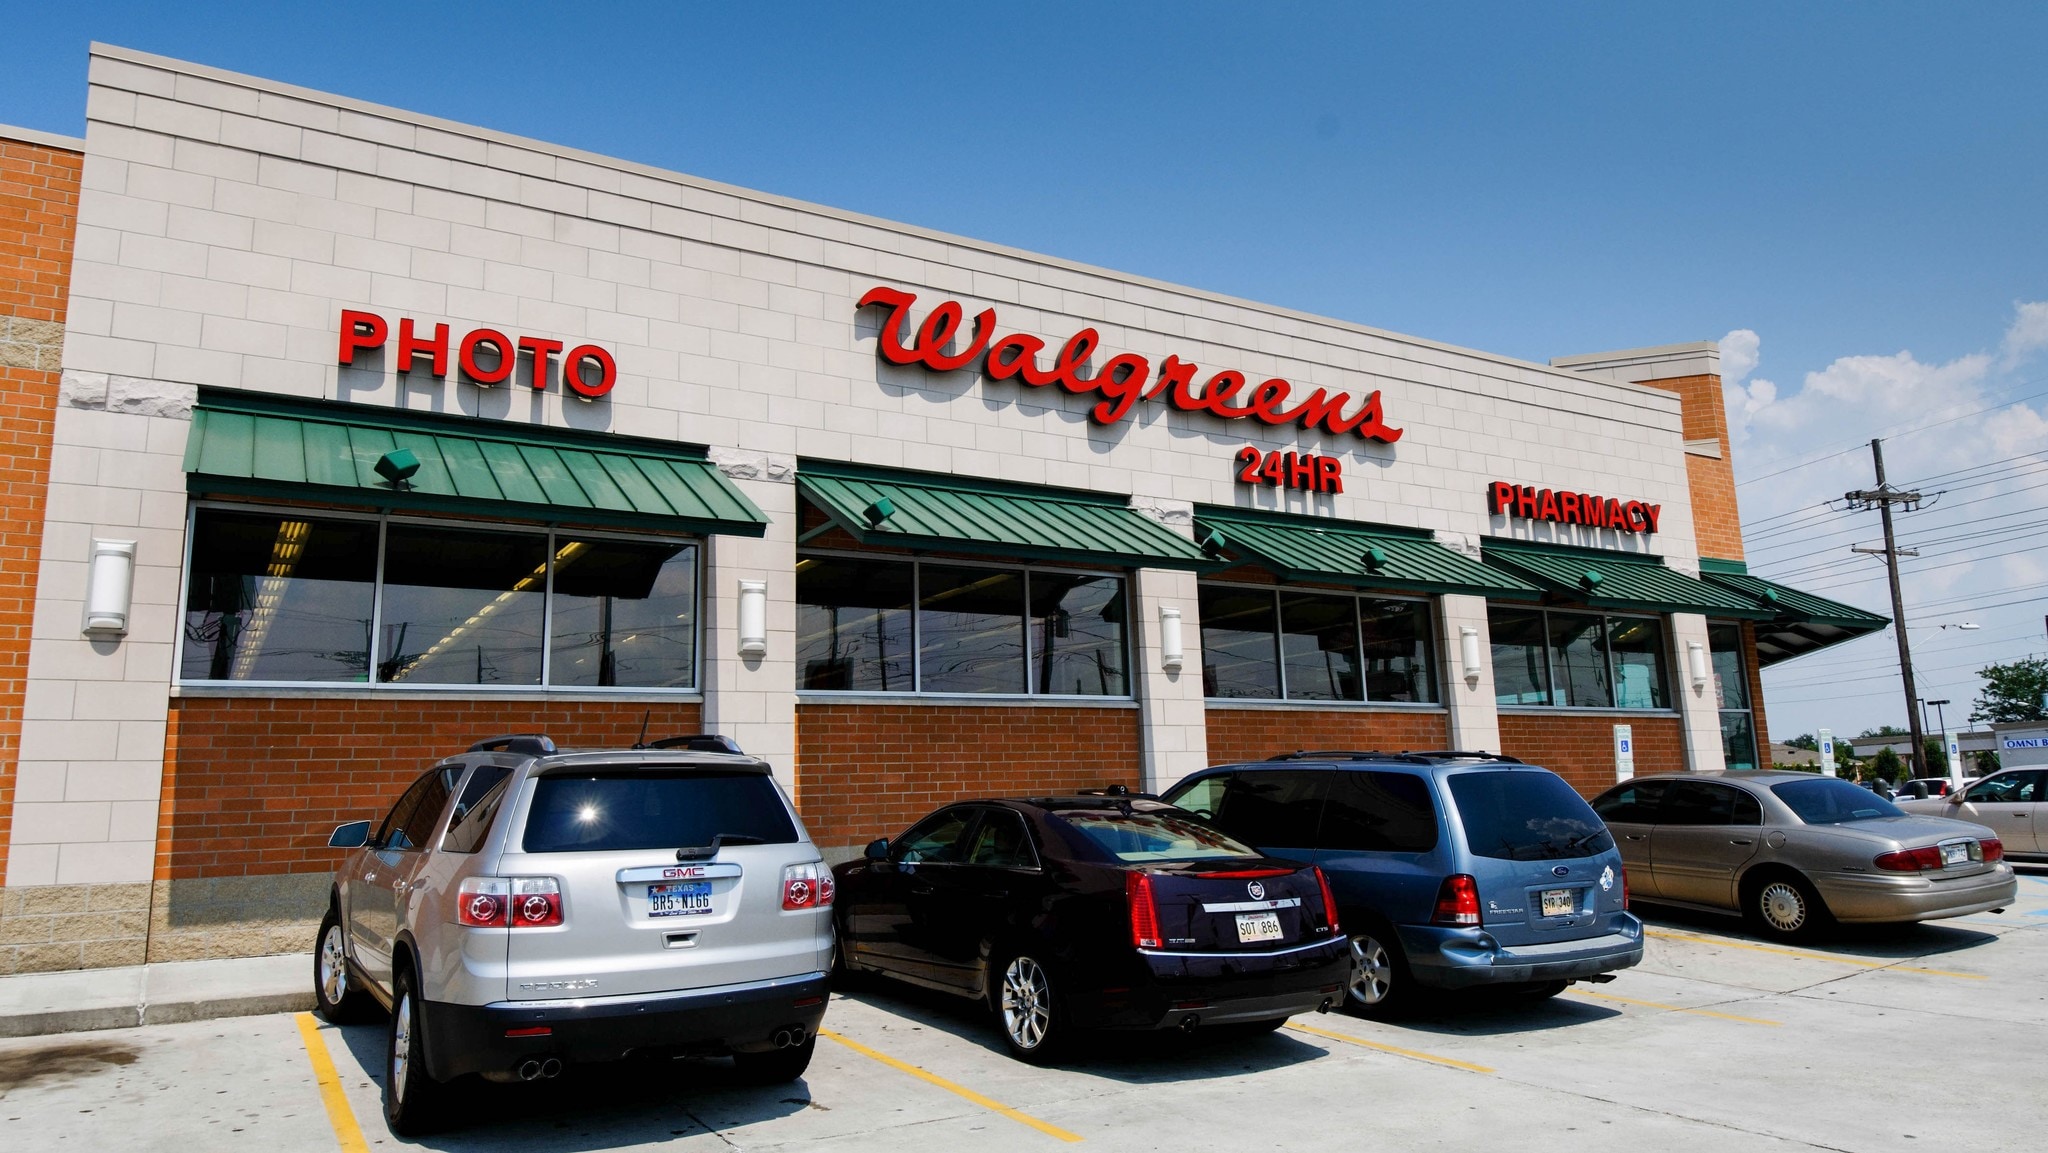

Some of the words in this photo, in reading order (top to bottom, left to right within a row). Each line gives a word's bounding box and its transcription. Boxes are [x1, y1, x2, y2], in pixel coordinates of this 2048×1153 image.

[338, 309, 618, 398] PHOTO
[856, 286, 1403, 444] Walgreens
[1236, 446, 1344, 494] 24HR
[1489, 481, 1662, 534] PHARMACY
[2006, 740, 2038, 748] OMNI
[663, 867, 705, 878] GMC
[665, 884, 694, 893] TEXAS
[1558, 896, 1571, 908] 340
[1261, 920, 1279, 934] 886
